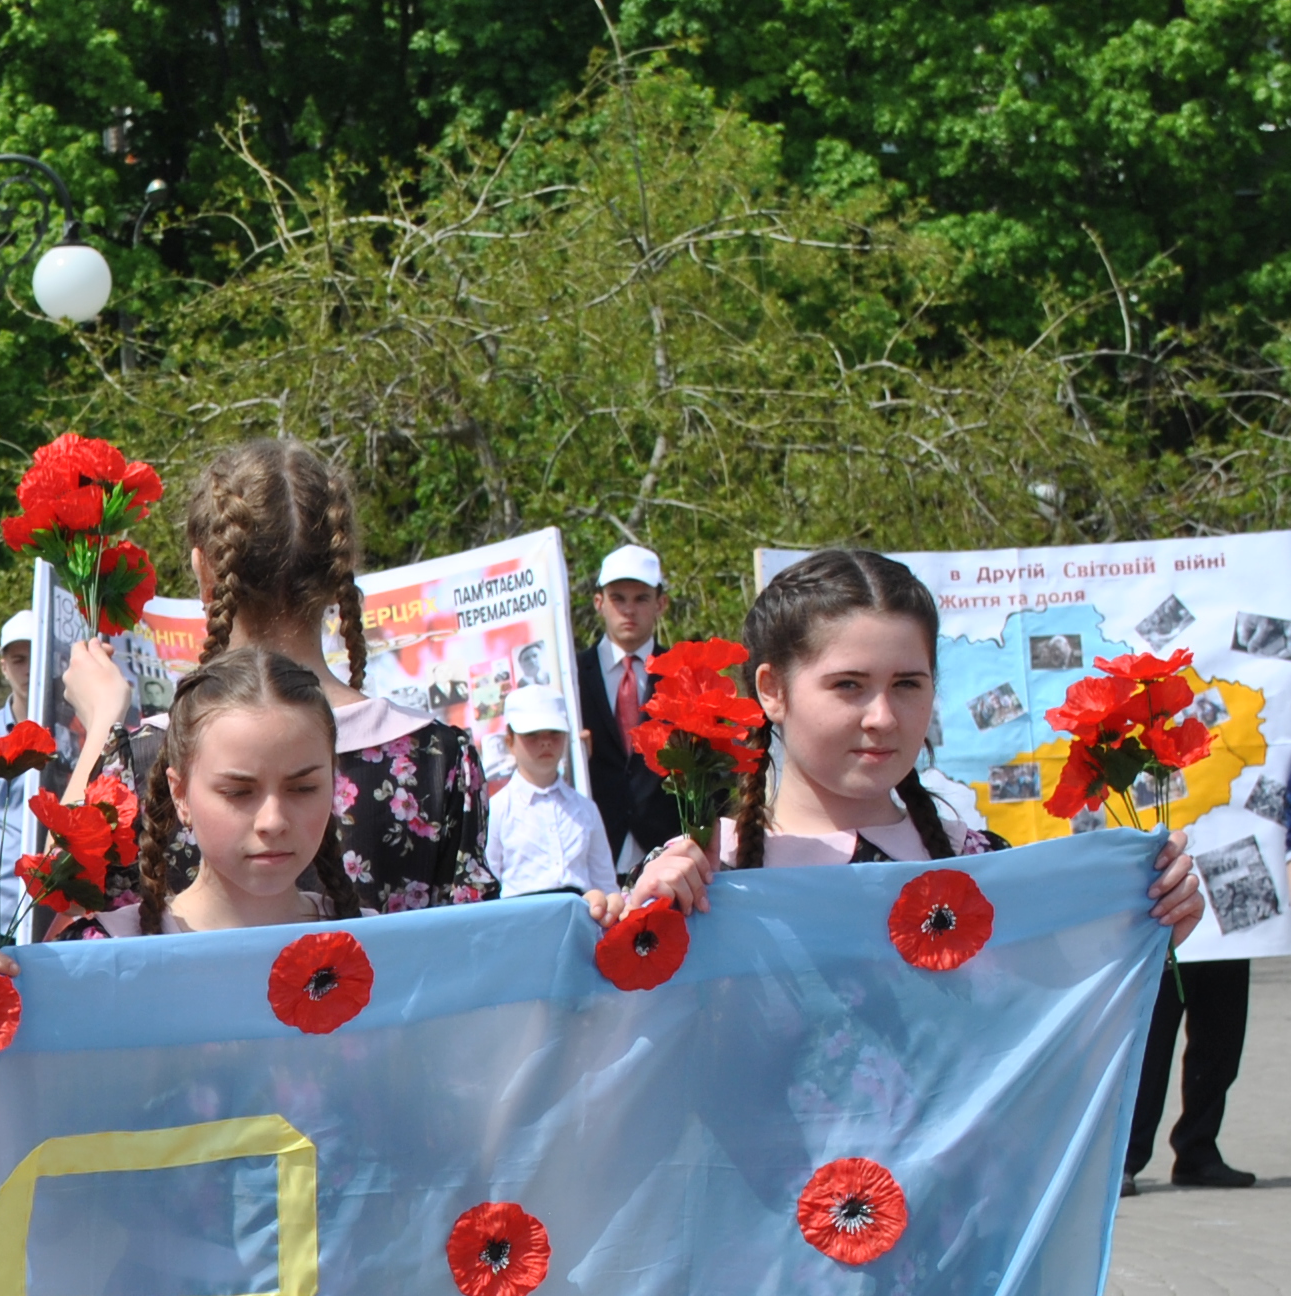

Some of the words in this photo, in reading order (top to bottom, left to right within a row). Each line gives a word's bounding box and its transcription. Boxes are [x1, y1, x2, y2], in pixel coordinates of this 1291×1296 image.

[949, 569, 961, 581] в
[976, 563, 1045, 584] Другій
[1062, 556, 1156, 579] Світовій
[1174, 553, 1226, 572] війні
[453, 568, 534, 607] ПАМ'ЯТАЄМО
[938, 594, 1001, 610] Життя
[1007, 594, 1029, 607] та
[1036, 590, 1086, 607] доля
[362, 597, 439, 630] ЕРЦЯХ
[456, 588, 547, 630] ПЕРЕМАГАЄМО
